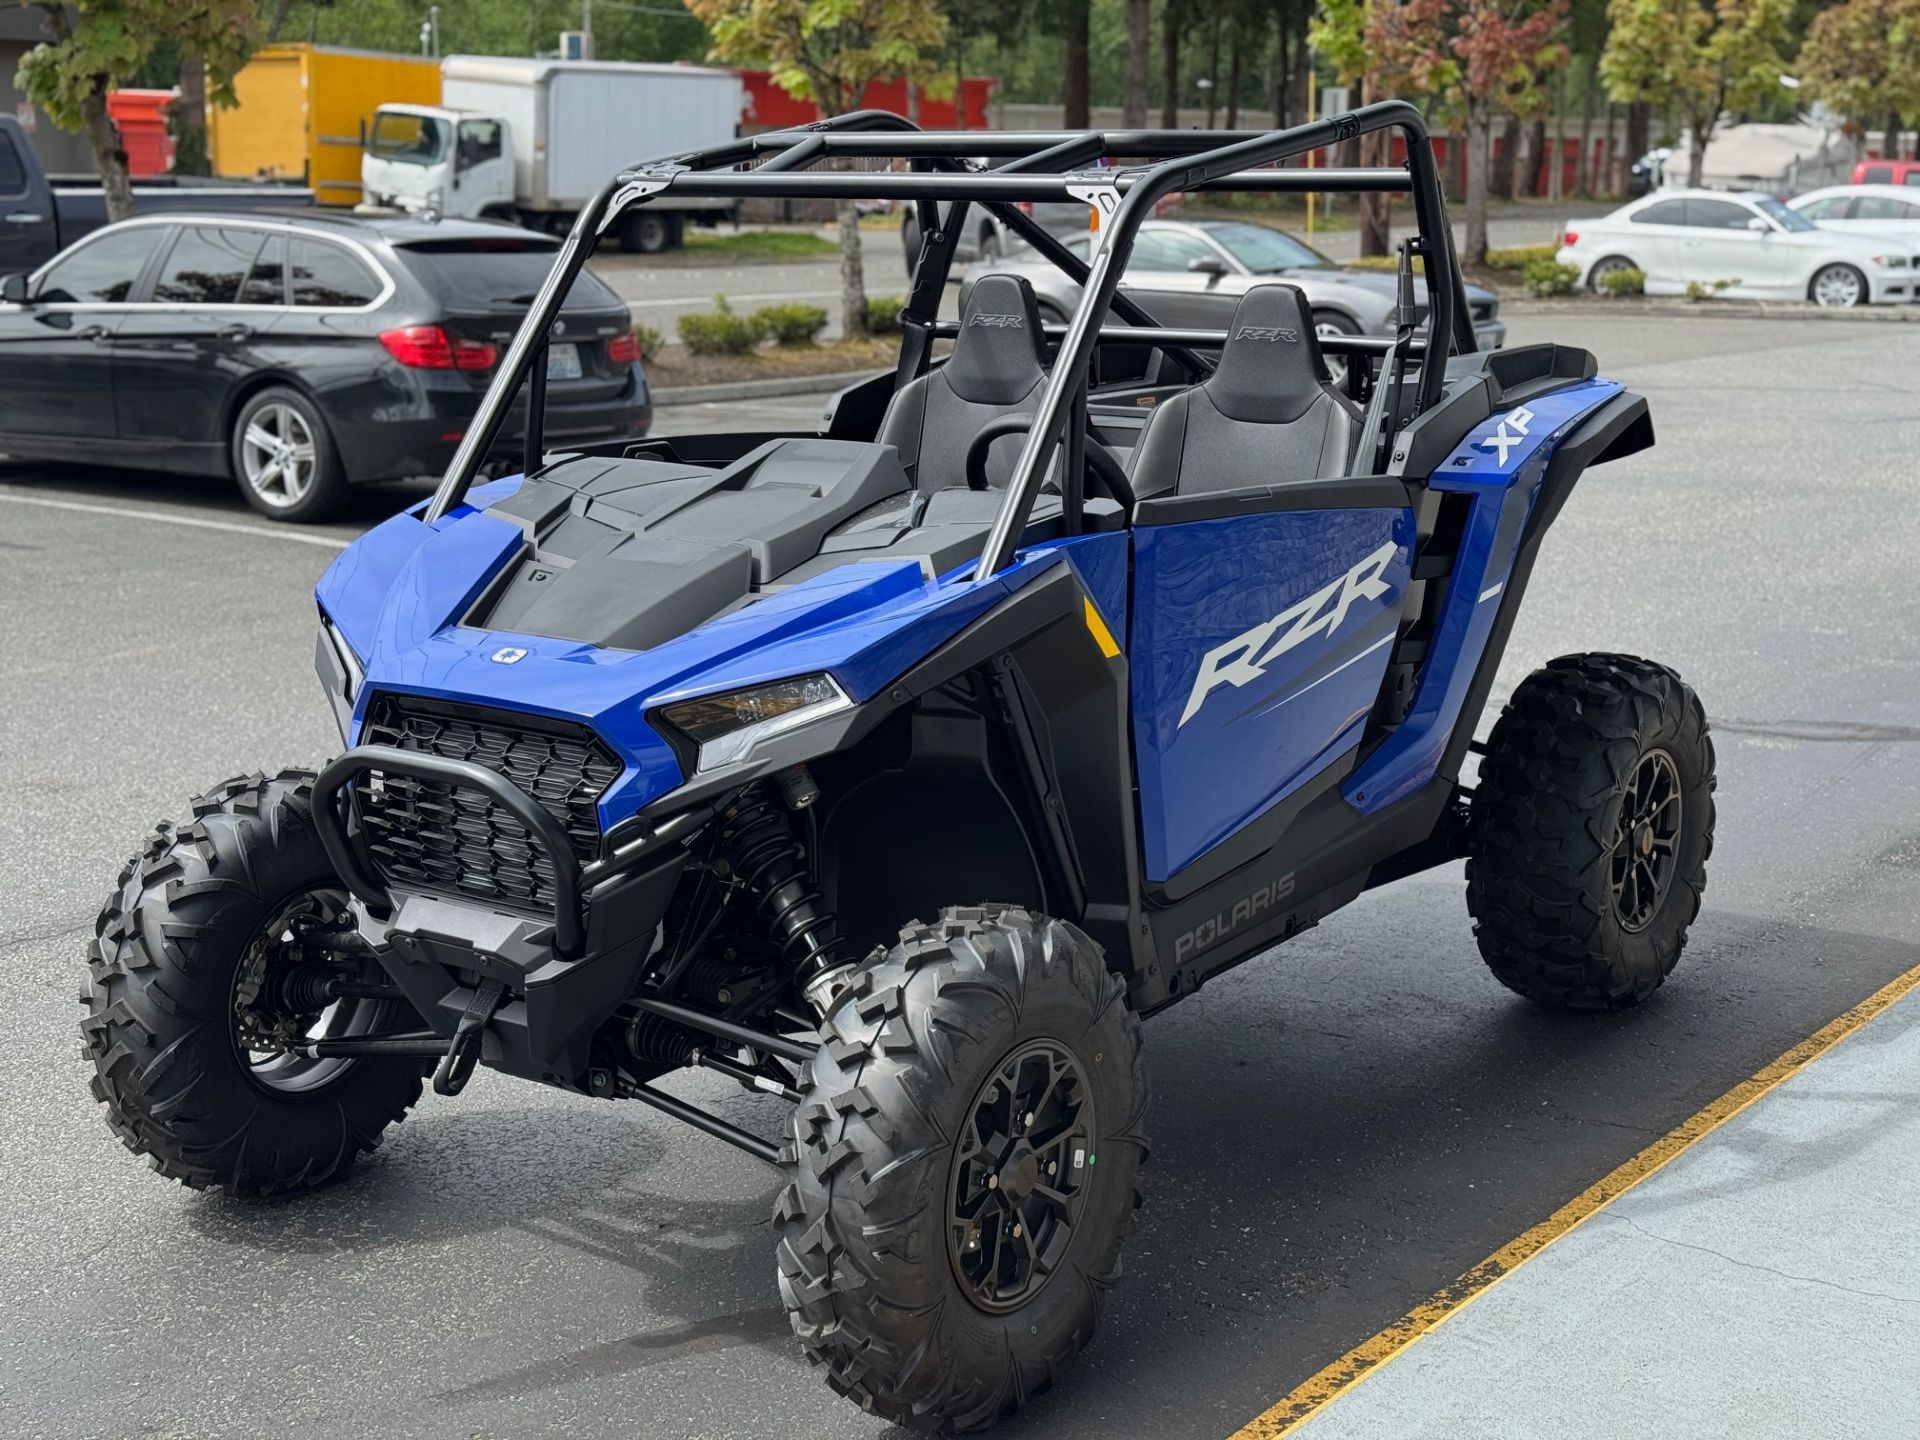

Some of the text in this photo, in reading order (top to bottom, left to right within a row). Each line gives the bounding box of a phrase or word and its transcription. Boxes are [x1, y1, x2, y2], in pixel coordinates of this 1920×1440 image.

[969, 313, 1022, 328] RZR
[1235, 326, 1298, 341] RZR
[1481, 406, 1535, 468] XP
[1177, 540, 1398, 730] RZR
[1175, 871, 1295, 964] POLARIS
